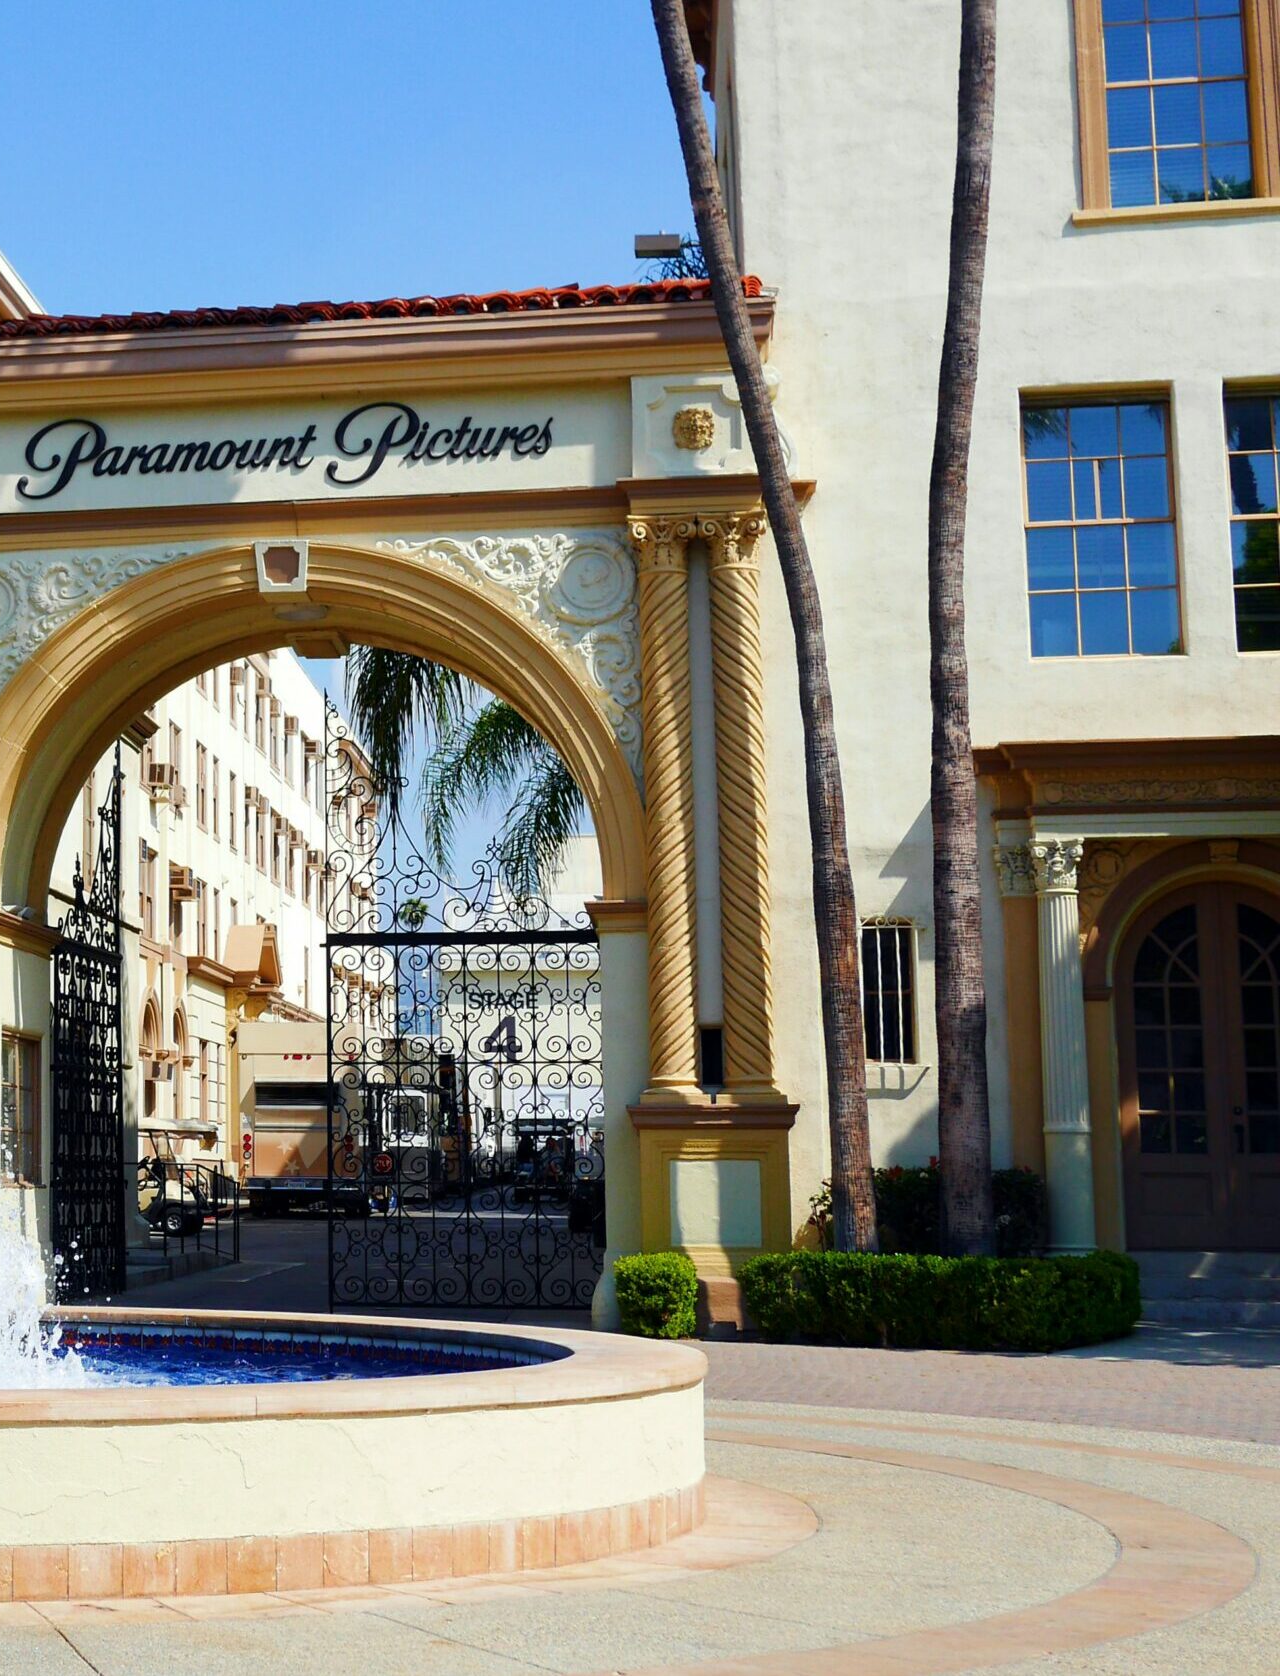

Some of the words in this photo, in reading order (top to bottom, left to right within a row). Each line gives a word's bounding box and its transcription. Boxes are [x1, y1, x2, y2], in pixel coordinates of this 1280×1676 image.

[17, 418, 316, 499] Paramount
[326, 402, 553, 484] Pictures
[468, 992, 539, 1010] STAGE
[484, 1016, 522, 1062] 4
